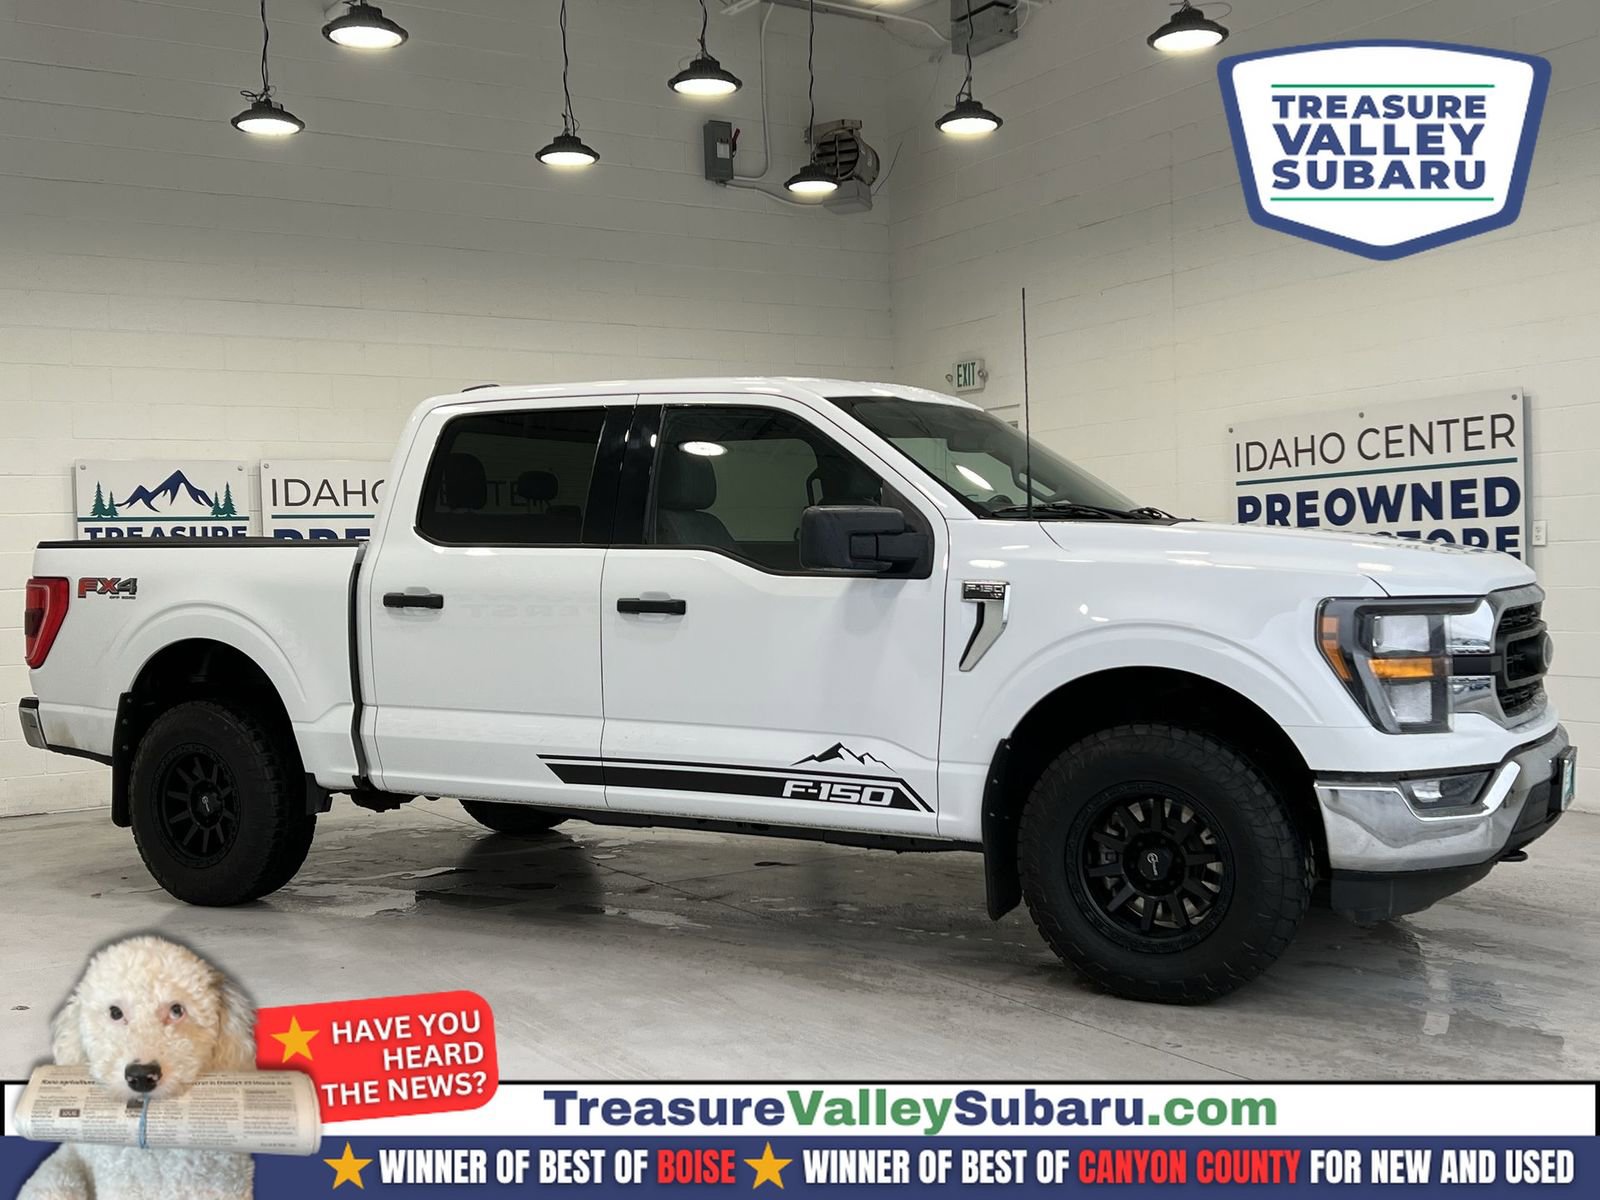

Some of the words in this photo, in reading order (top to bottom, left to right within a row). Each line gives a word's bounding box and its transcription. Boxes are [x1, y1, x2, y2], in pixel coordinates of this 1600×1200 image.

[957, 362, 976, 388] EXIT
[1236, 432, 1346, 473] IDAHO
[1357, 413, 1516, 460] CENTER
[1237, 476, 1521, 527] PREOWNED
[78, 577, 138, 598] FX4
[964, 584, 1004, 593] F-150
[782, 780, 895, 807] F-150
